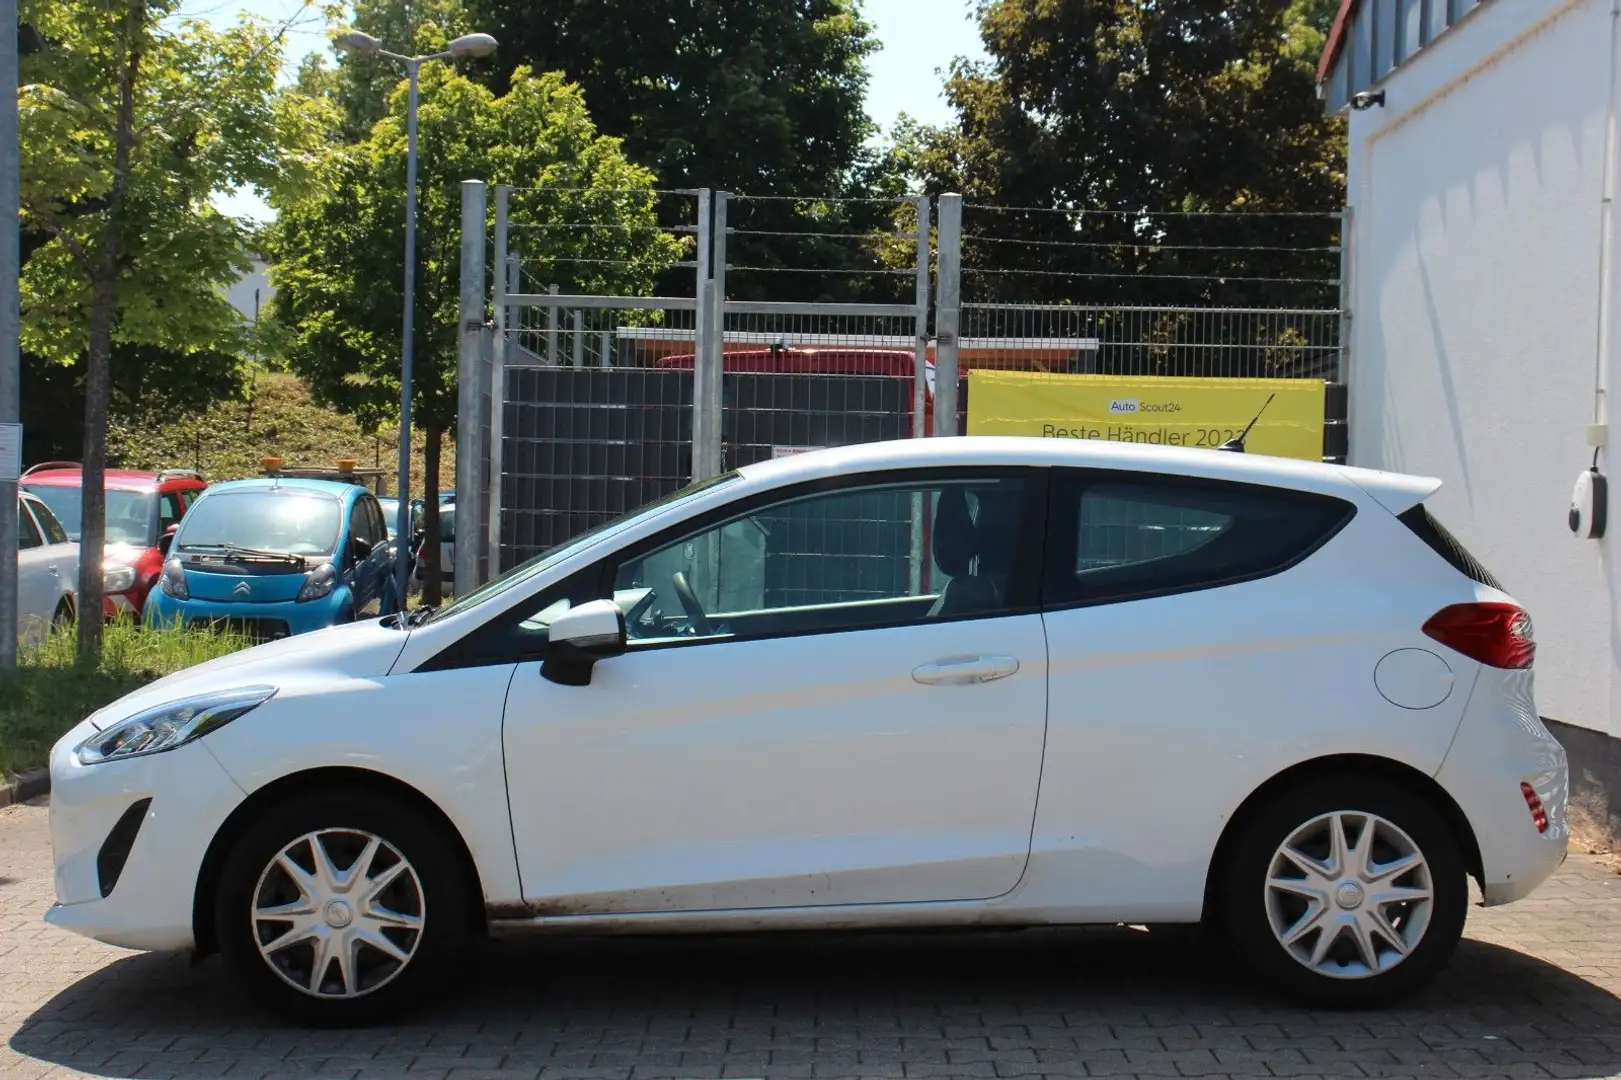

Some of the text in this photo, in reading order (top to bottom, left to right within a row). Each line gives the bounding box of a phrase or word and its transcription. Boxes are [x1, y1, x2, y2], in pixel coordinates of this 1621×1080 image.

[1111, 401, 1182, 412] Auto Scout24
[1042, 424, 1100, 440] Beste
[1108, 426, 1190, 446] Händler
